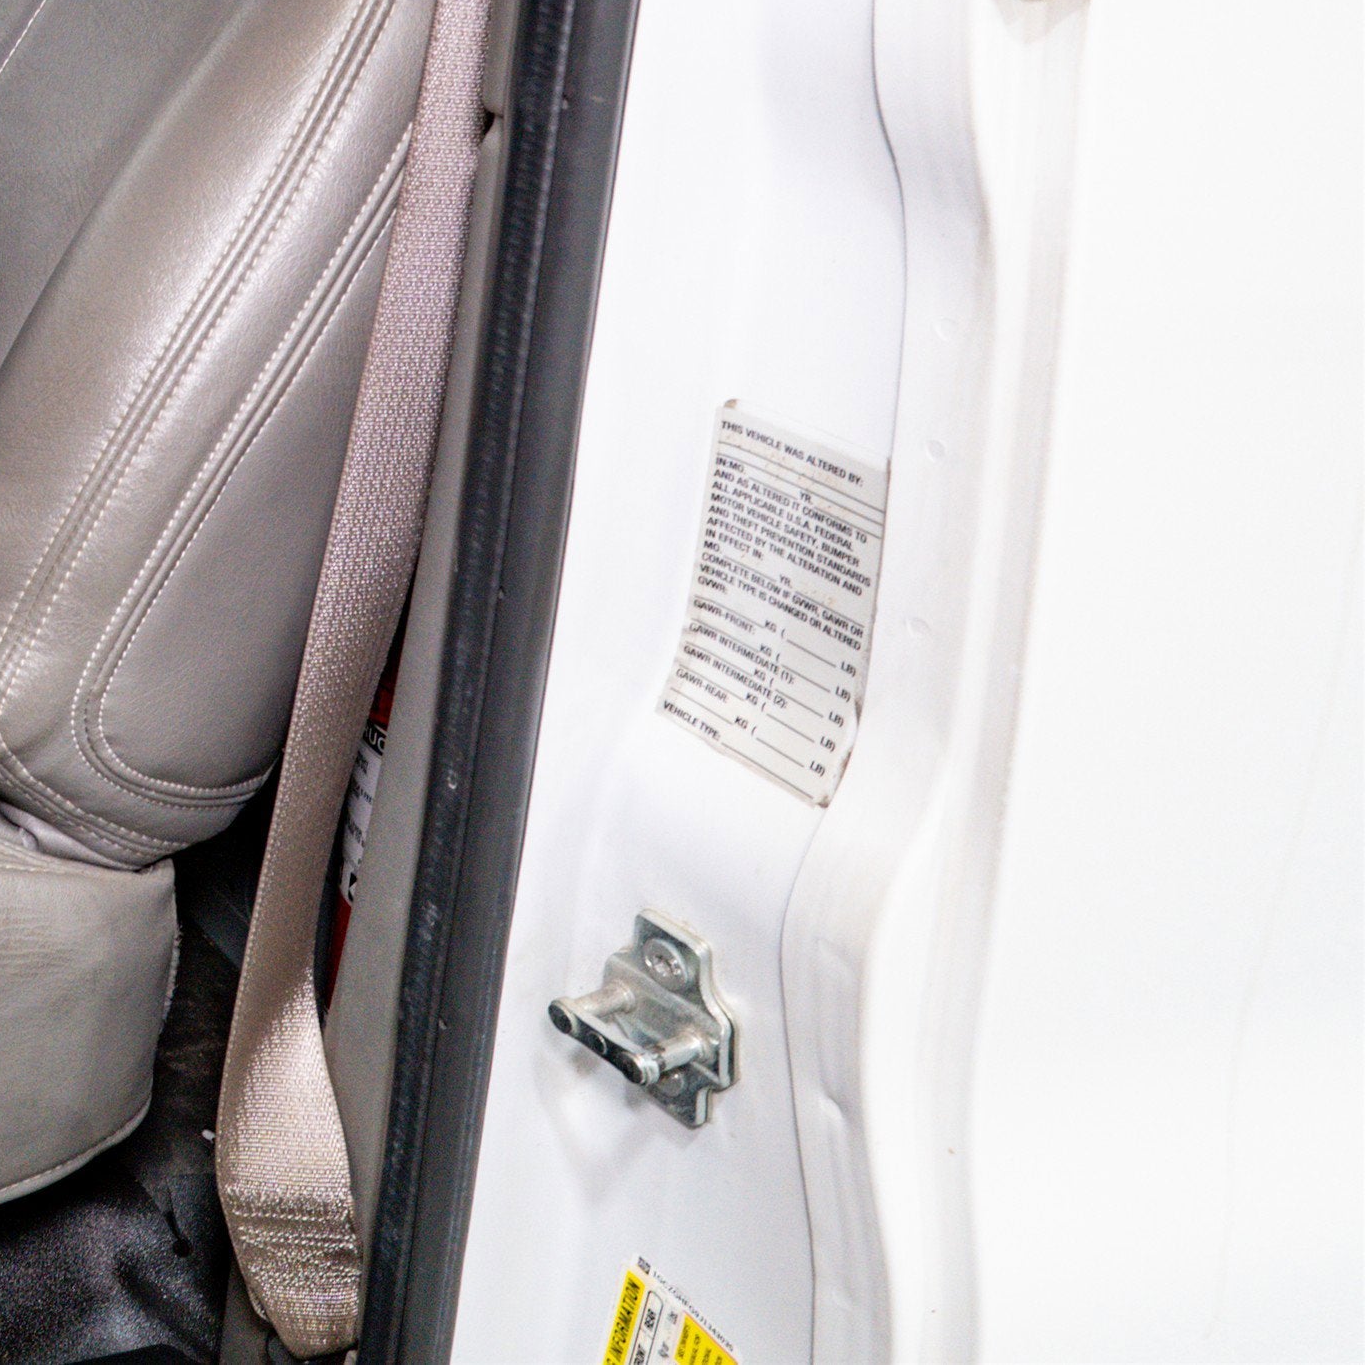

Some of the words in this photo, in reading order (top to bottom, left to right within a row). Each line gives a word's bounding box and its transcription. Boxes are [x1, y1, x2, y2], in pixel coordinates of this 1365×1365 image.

[721, 420, 743, 435] THIS
[745, 428, 780, 450] VEHICLE
[784, 444, 803, 460] WAS
[806, 454, 846, 479] ALTERED
[848, 472, 863, 486] BY:
[711, 492, 743, 513] MOTOR
[746, 506, 780, 529] VEHICLE
[821, 542, 859, 567] BUMPER
[712, 480, 730, 494] ALL
[732, 487, 783, 518] APPLICABLE
[814, 525, 854, 551] FEDERAL
[714, 468, 733, 483] AND
[736, 477, 748, 488] AS
[751, 483, 789, 507] ALTERED
[791, 501, 799, 511] IT
[802, 506, 852, 537] CONFORMS
[855, 531, 867, 544] TO
[705, 527, 715, 539] IN
[718, 532, 749, 554] EFFECT
[707, 515, 751, 543] AFFECTED
[755, 537, 765, 548] BY
[769, 543, 784, 557] THE
[787, 552, 840, 586] ALTERATION
[842, 579, 862, 596] AND
[709, 504, 728, 520] AND
[732, 513, 757, 532] THEFT
[761, 526, 814, 558] PREVENTION
[816, 553, 871, 586] STANDARDS
[700, 562, 734, 586] VEHICLE
[737, 579, 756, 596] TYPE
[758, 589, 766, 601] IS
[768, 595, 807, 623] CHANGED
[810, 616, 821, 629] OR
[822, 623, 861, 651] ALTERED
[702, 550, 748, 581] COMPLETE
[751, 573, 780, 595] BELOW
[783, 589, 790, 600] IF
[822, 609, 848, 630] GAWR
[850, 624, 863, 638] OR
[683, 643, 711, 665] GAWR
[712, 658, 772, 699] INTERMEDIATE
[773, 693, 787, 709] (2):
[689, 619, 716, 642] GAWR
[718, 634, 779, 675] INTERMEDIATE
[780, 669, 795, 685] (1):
[759, 643, 771, 657] KG
[835, 685, 850, 702] LB)
[764, 619, 776, 632] KG
[840, 661, 856, 677] LB)
[663, 700, 697, 727] VEHICLE
[745, 691, 757, 706] KG
[820, 734, 835, 752] LB)
[753, 668, 765, 681] KG
[828, 710, 843, 727] LB)
[734, 714, 747, 730] KG
[809, 759, 824, 777] LB)
[609, 1278, 641, 1362] INFORMATION
